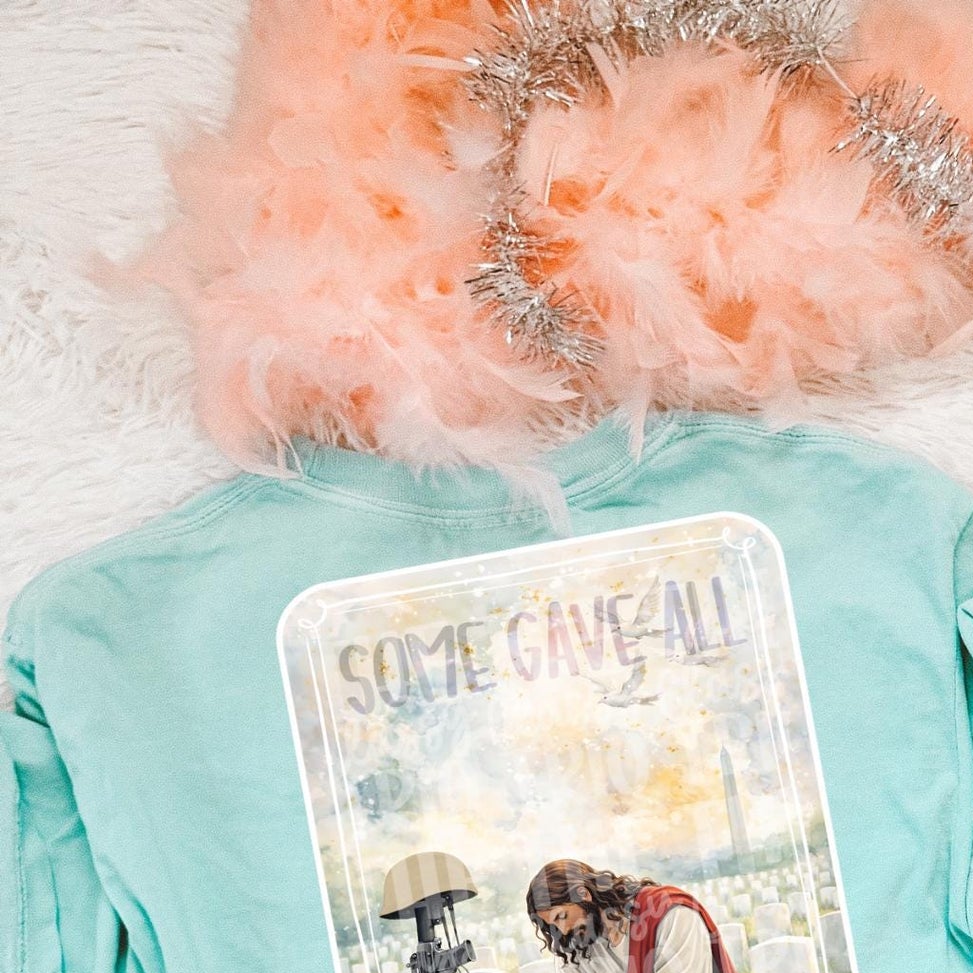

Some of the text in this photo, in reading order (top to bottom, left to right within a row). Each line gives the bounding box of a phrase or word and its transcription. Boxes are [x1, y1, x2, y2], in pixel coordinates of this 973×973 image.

[338, 620, 497, 716] SOME
[506, 593, 648, 682] GAVE
[663, 576, 749, 657] ALL
